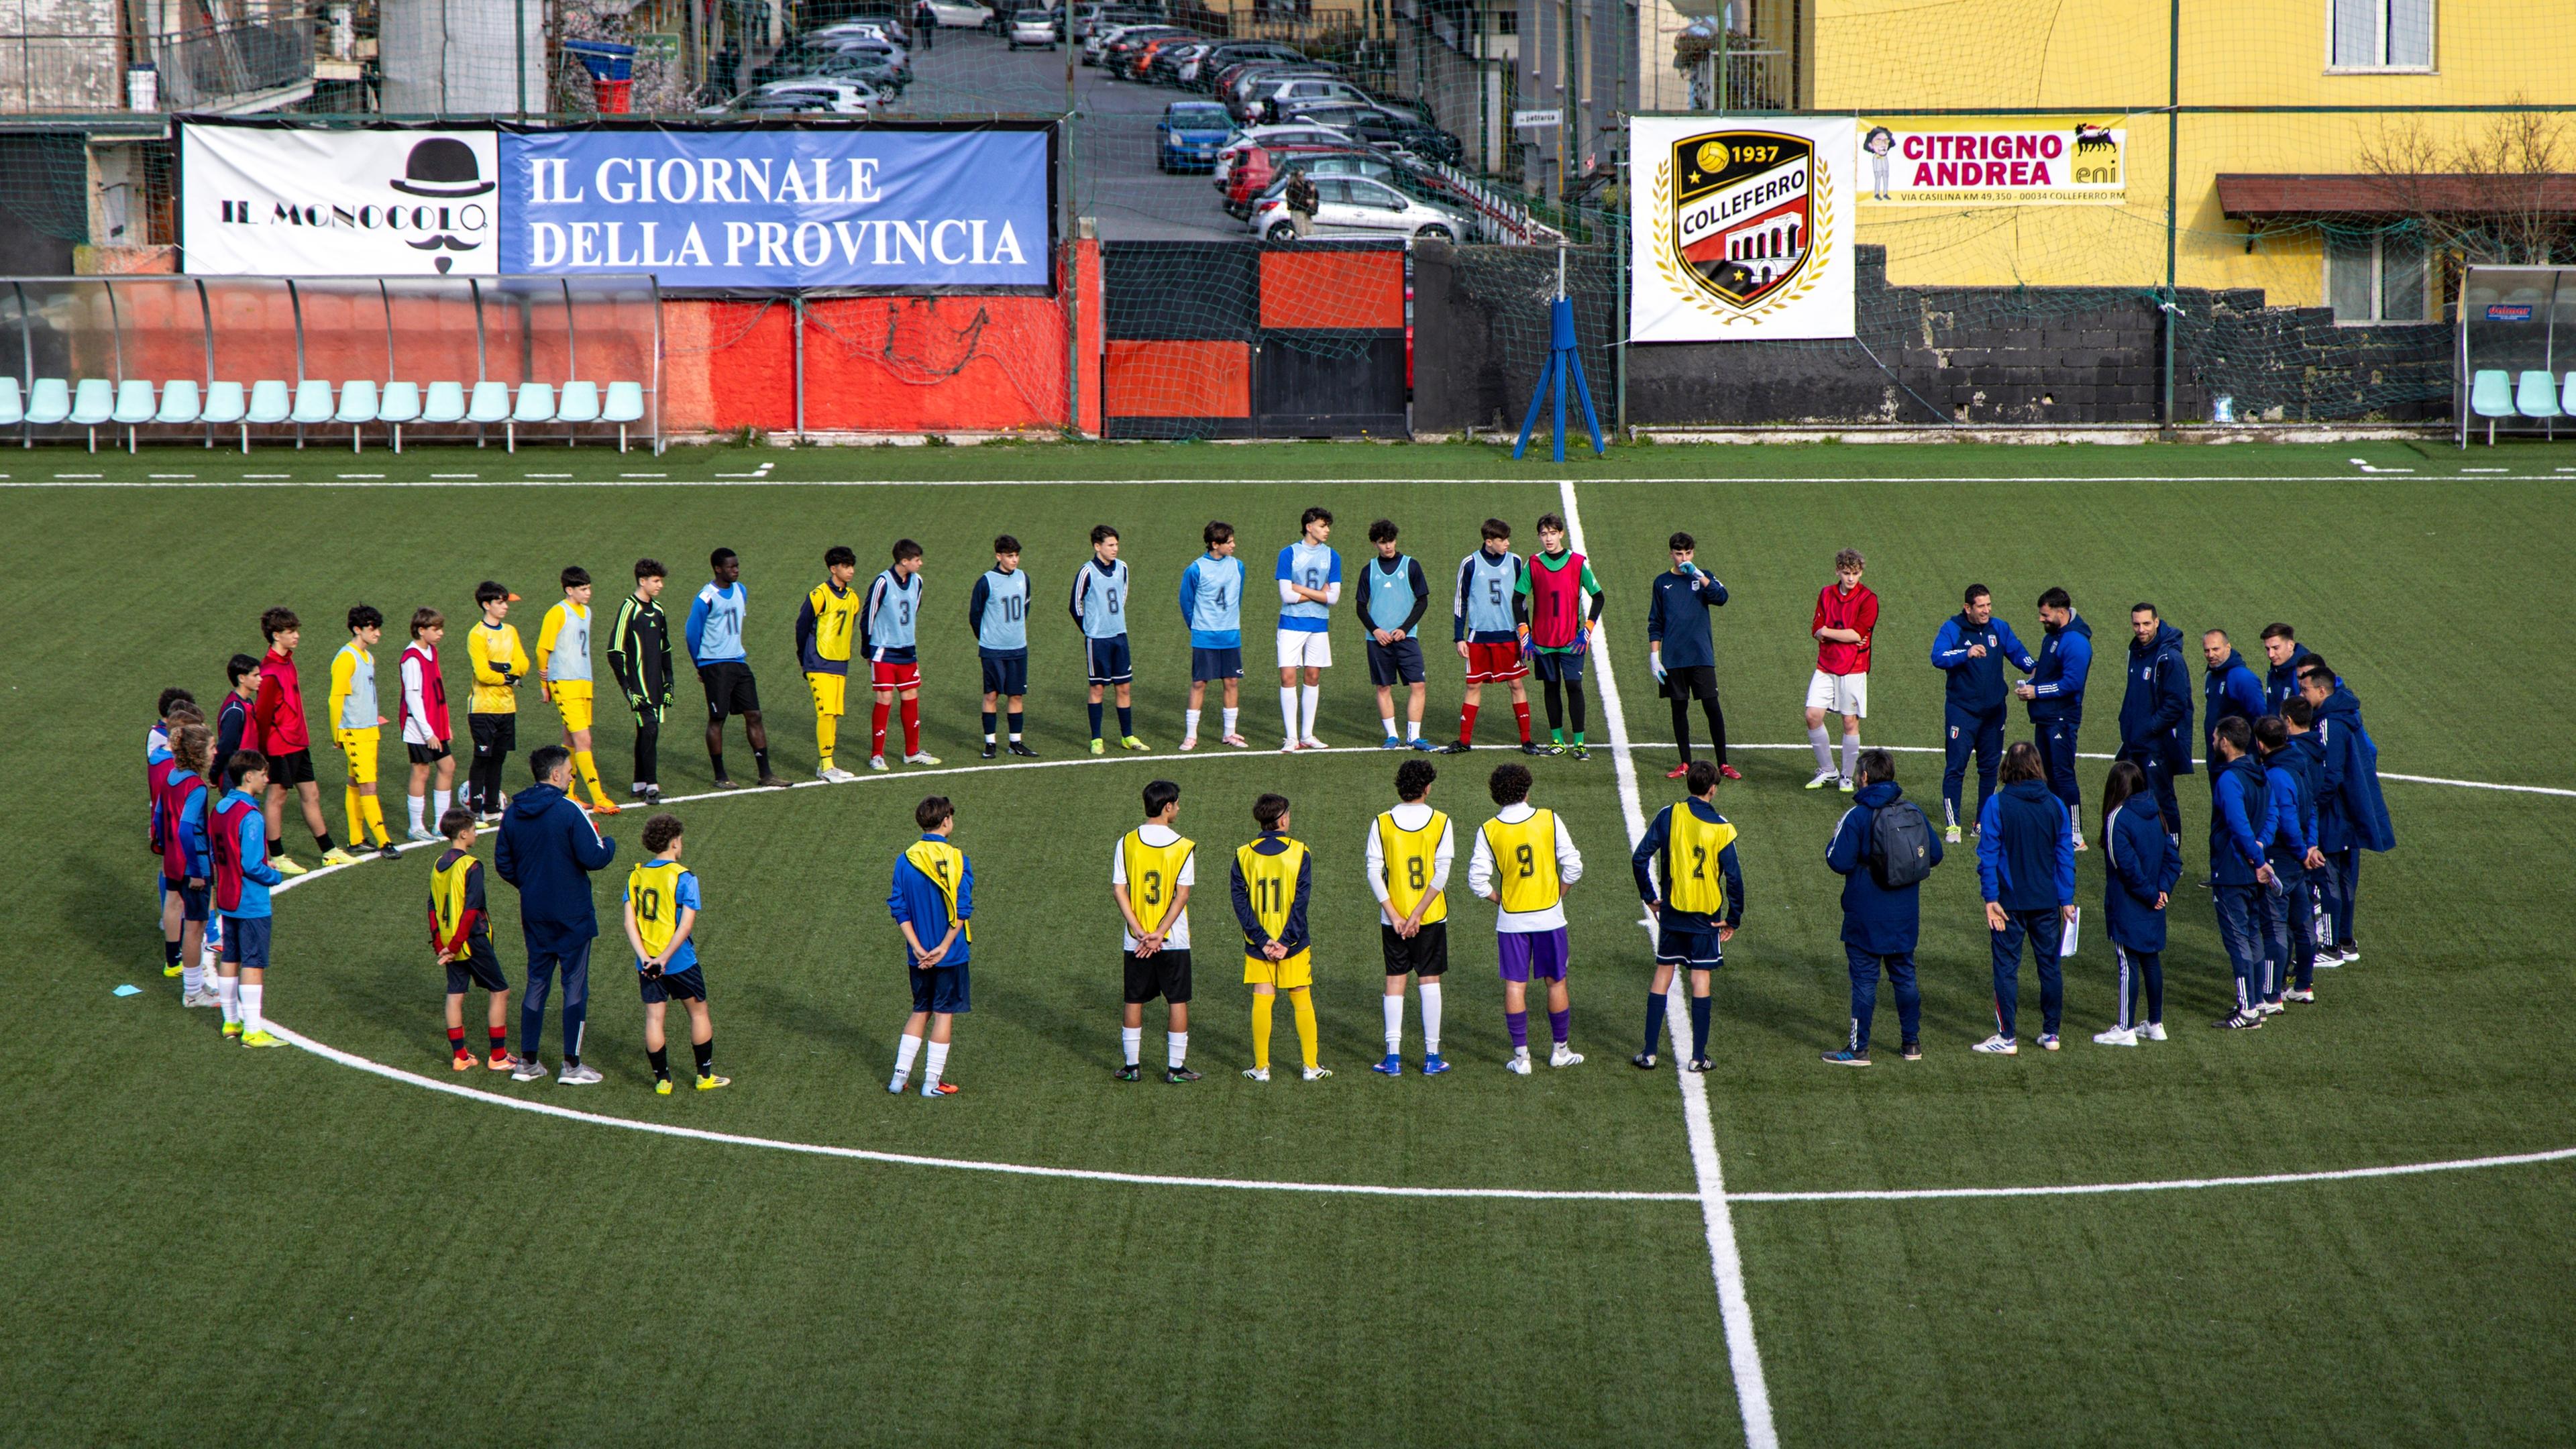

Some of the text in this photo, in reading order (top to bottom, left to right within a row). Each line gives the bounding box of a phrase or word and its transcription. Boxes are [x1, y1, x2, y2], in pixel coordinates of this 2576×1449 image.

[1732, 146, 1779, 162] 1937
[1903, 135, 2063, 160] CITRIGNO
[529, 158, 881, 204] IL GIORNALE
[1913, 161, 2052, 186] ANDREA
[2076, 160, 2116, 183] eni
[1682, 170, 1805, 235] COLLEFERRO
[1981, 193, 2012, 201] 49,350
[2019, 192, 2047, 200] 00034
[2050, 192, 2108, 200] COLLEFERRO
[222, 200, 488, 231] IL MONOCOLO
[531, 219, 1028, 267] DELLA PROVINCIA
[1106, 587, 1120, 615] 8
[1215, 585, 1228, 612] 4
[1487, 578, 1502, 606] 5
[1550, 590, 1560, 618] 1
[724, 606, 739, 635] 11
[836, 609, 848, 637] 7
[899, 600, 911, 627] 3
[1001, 594, 1022, 624] 10
[578, 629, 588, 658] 2
[1406, 855, 1425, 891] 8
[1514, 843, 1536, 879] 9
[1690, 844, 1707, 880] 2
[1142, 869, 1162, 907] 3
[1257, 877, 1282, 914] 11
[441, 892, 451, 929] 4
[633, 885, 659, 923] 10
